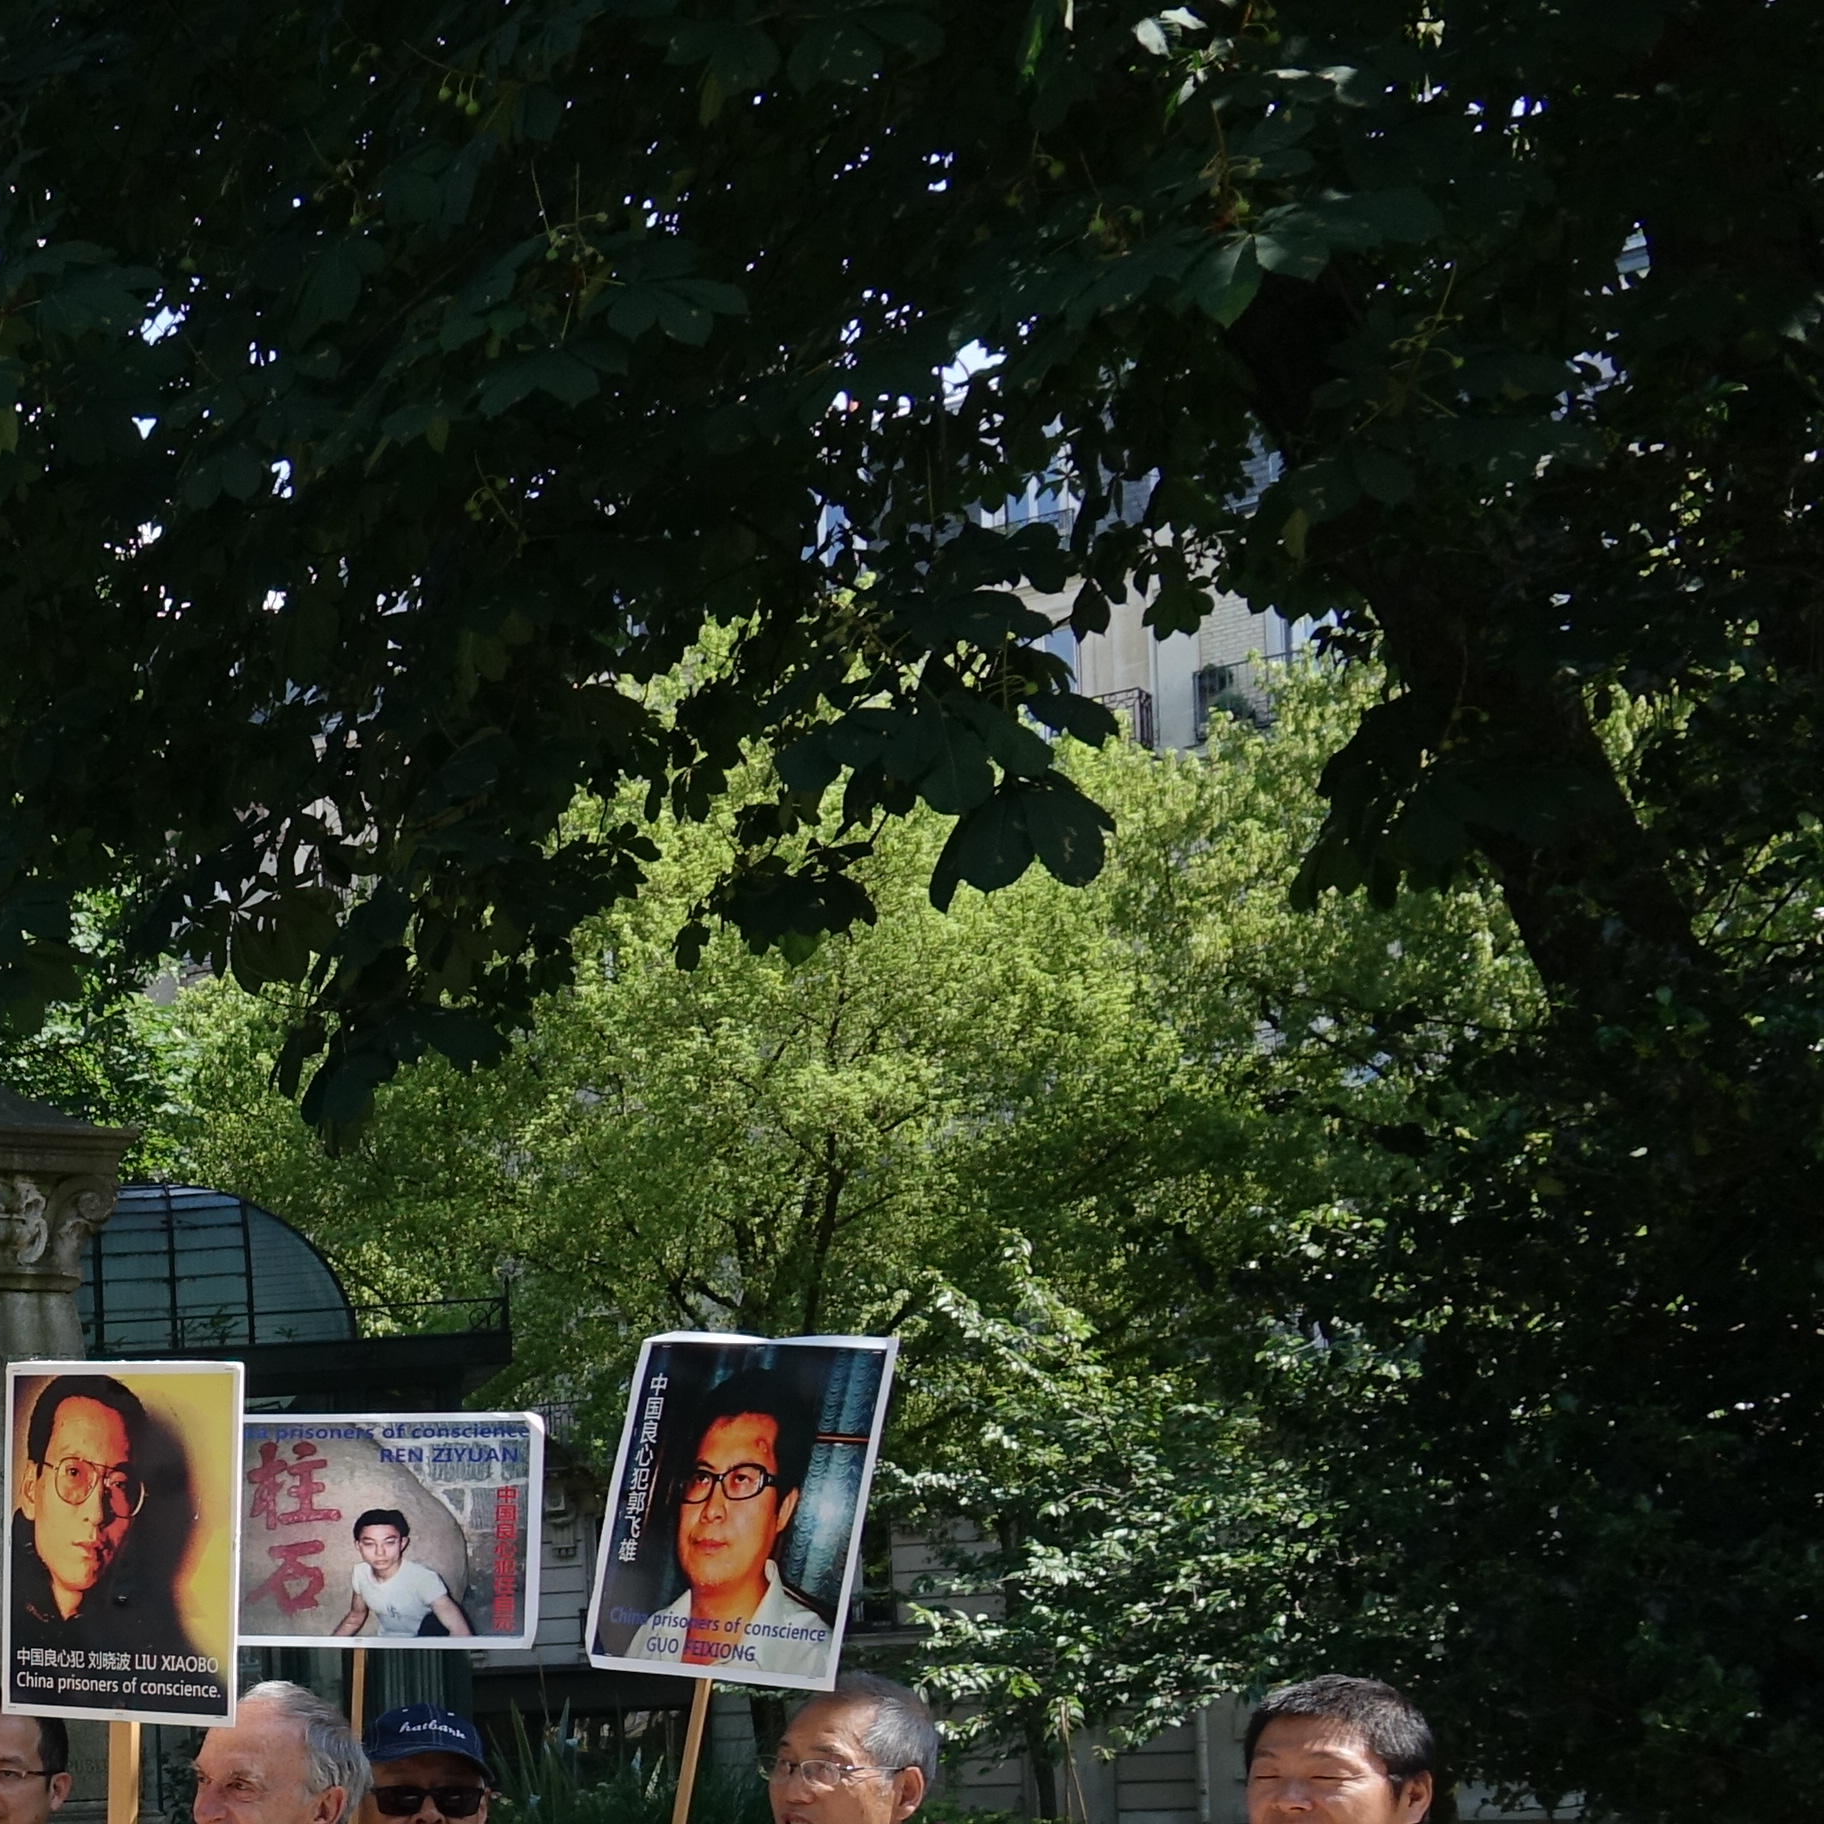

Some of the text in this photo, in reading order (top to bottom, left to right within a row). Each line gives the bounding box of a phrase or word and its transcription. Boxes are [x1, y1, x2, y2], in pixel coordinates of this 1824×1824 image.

[276, 1425, 374, 1443] prisoners
[382, 1423, 405, 1439] of
[411, 1424, 530, 1440] conscience
[380, 1447, 519, 1463] REN ZIYUAN
[618, 1373, 668, 1562] 中国良心犯郭飞雄
[610, 1606, 826, 1642] China prisoners of conscience
[16, 1647, 219, 1674] 中国良心犯 刘晓波 LIU XIAOBO
[646, 1636, 756, 1662] GUO FEIXIONG
[16, 1671, 222, 1699] China prisoners of conscience.
